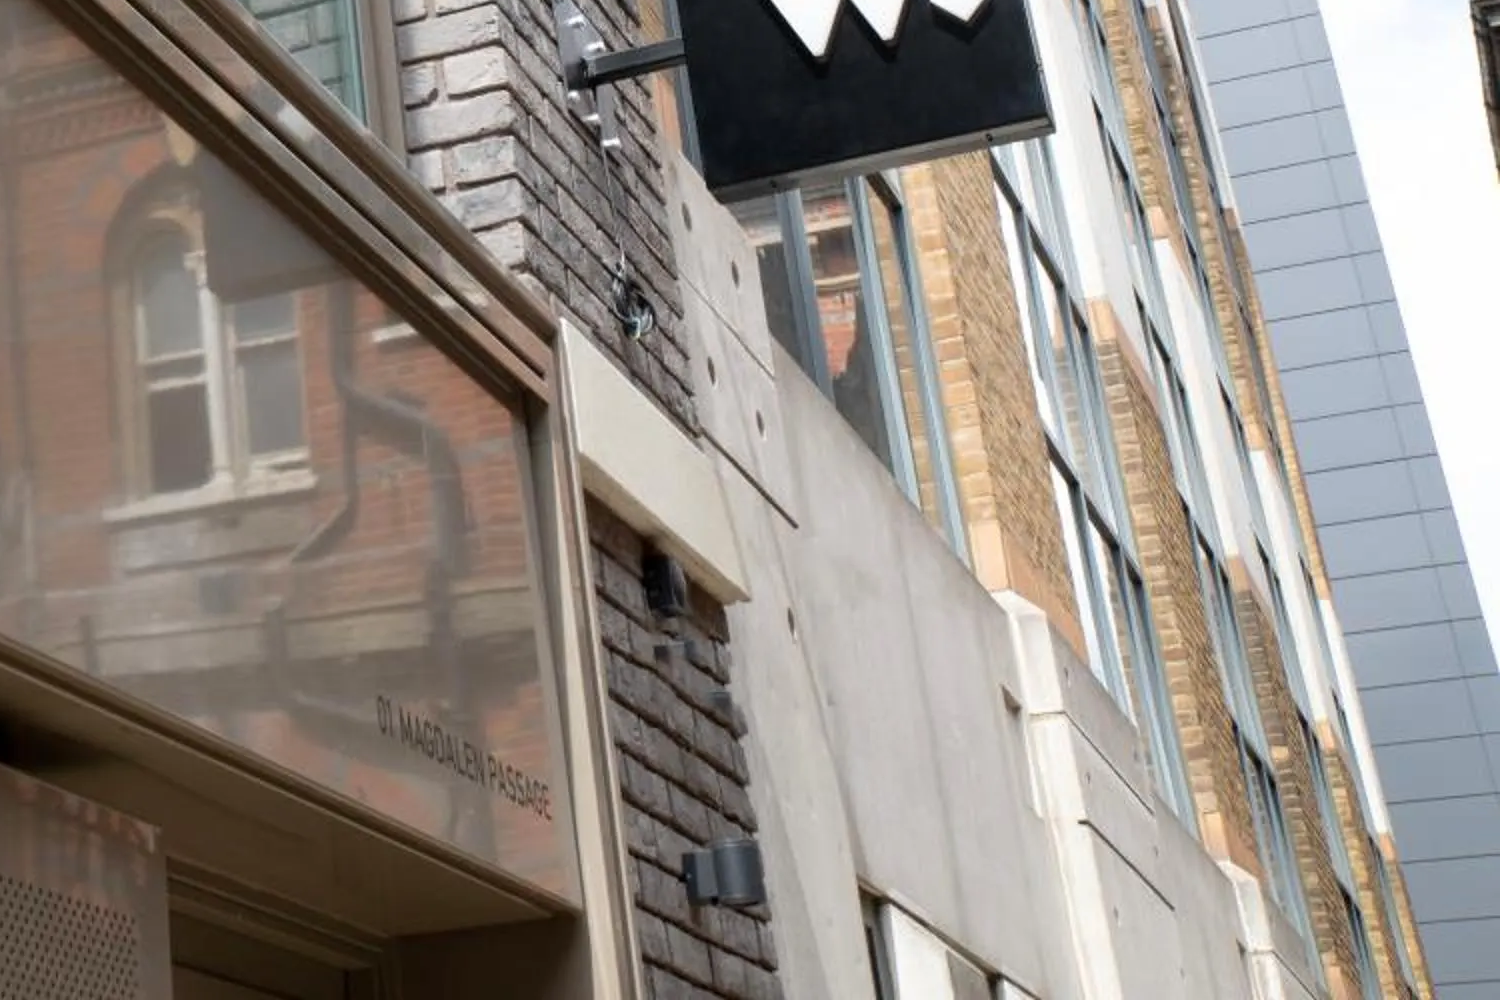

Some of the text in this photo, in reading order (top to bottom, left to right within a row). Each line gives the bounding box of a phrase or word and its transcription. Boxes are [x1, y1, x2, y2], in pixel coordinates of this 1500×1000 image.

[376, 694, 553, 822] 01 MAGDALEN PASSAGE
